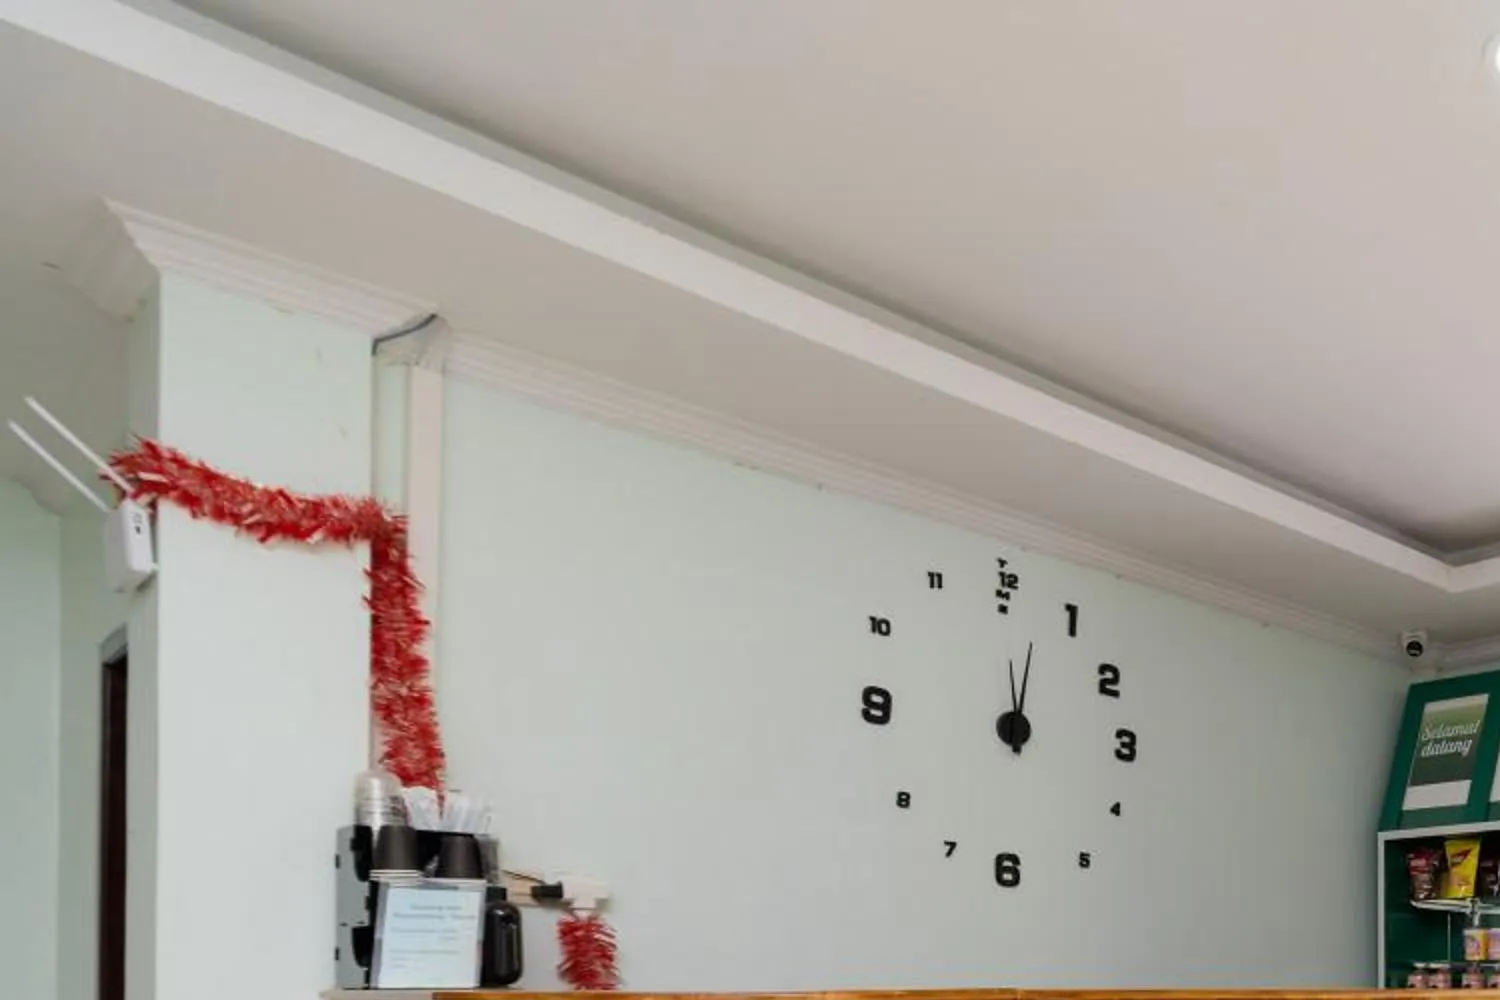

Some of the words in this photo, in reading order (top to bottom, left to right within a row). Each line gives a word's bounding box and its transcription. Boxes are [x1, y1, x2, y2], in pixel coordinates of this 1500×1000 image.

[927, 571, 944, 590] 11
[997, 570, 1020, 591] 12
[868, 615, 892, 637] 10
[1064, 602, 1079, 638] 1
[1097, 662, 1121, 699] 2
[860, 685, 893, 726] 9
[1421, 719, 1481, 741] Selamat
[1113, 727, 1137, 763] 3
[1420, 738, 1473, 758] datang
[895, 791, 911, 809] 8
[1109, 801, 1121, 817] 4
[943, 840, 958, 858] 7
[994, 852, 1021, 888] 6
[1078, 851, 1091, 869] 5
